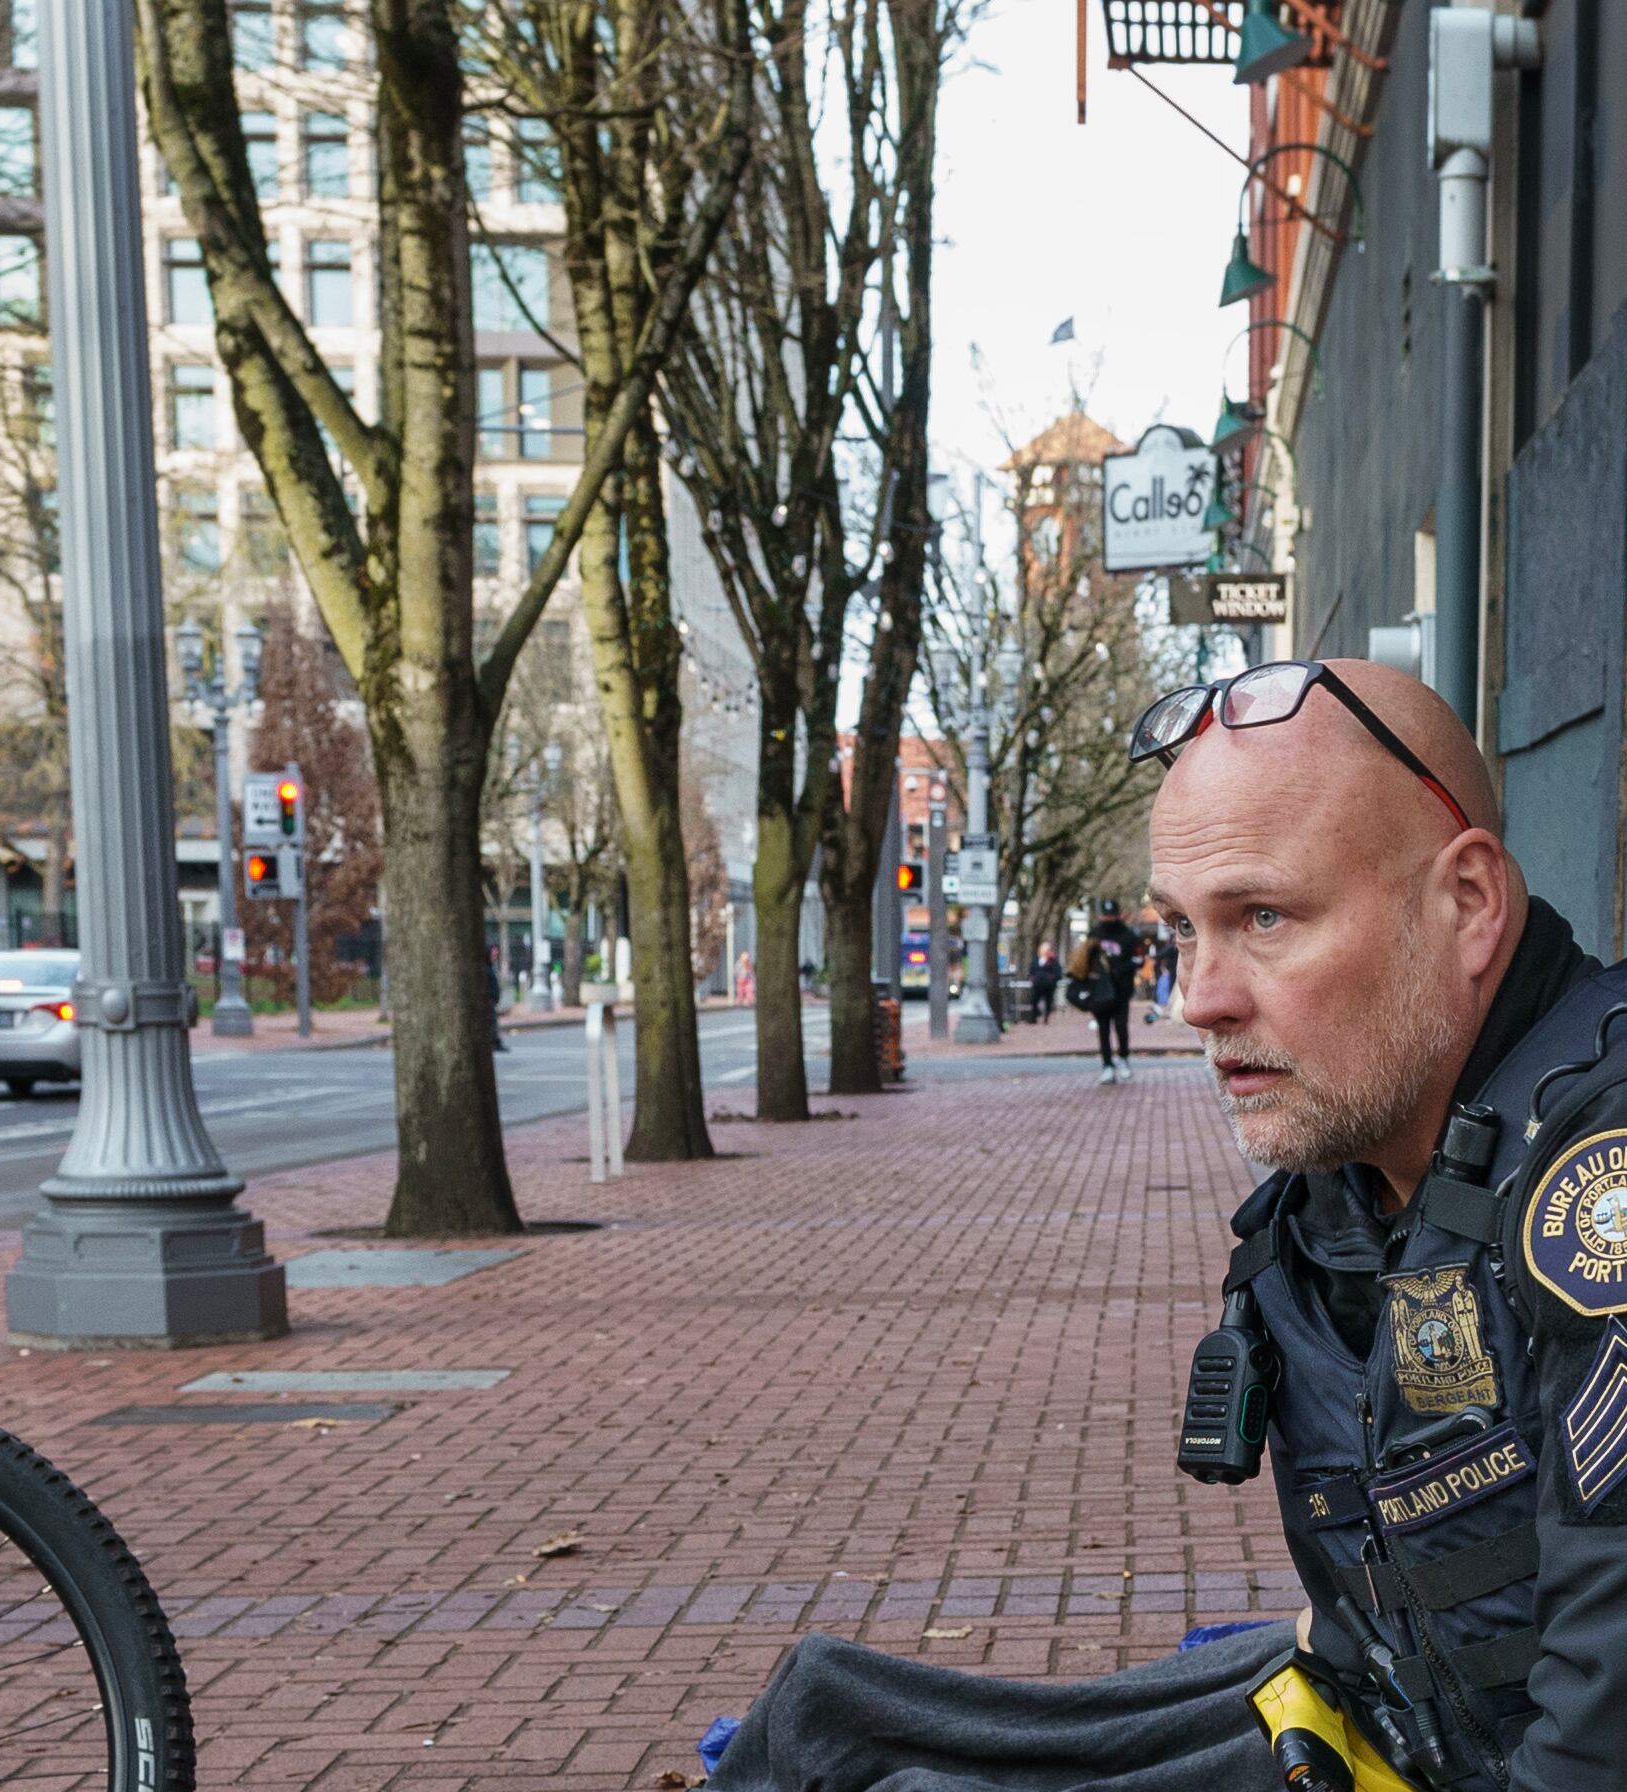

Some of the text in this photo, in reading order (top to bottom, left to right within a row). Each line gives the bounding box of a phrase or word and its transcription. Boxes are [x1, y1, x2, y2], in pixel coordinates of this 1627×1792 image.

[1216, 583, 1280, 601] TICKET
[1212, 599, 1286, 617] WINDOW
[1543, 1152, 1605, 1238] BUREAU
[1579, 1210, 1591, 1228] OF
[1581, 1228, 1607, 1254] CITY
[1185, 1437, 1222, 1445] MOTOROLA
[1378, 1443, 1526, 1525] PORTLAND POLICE
